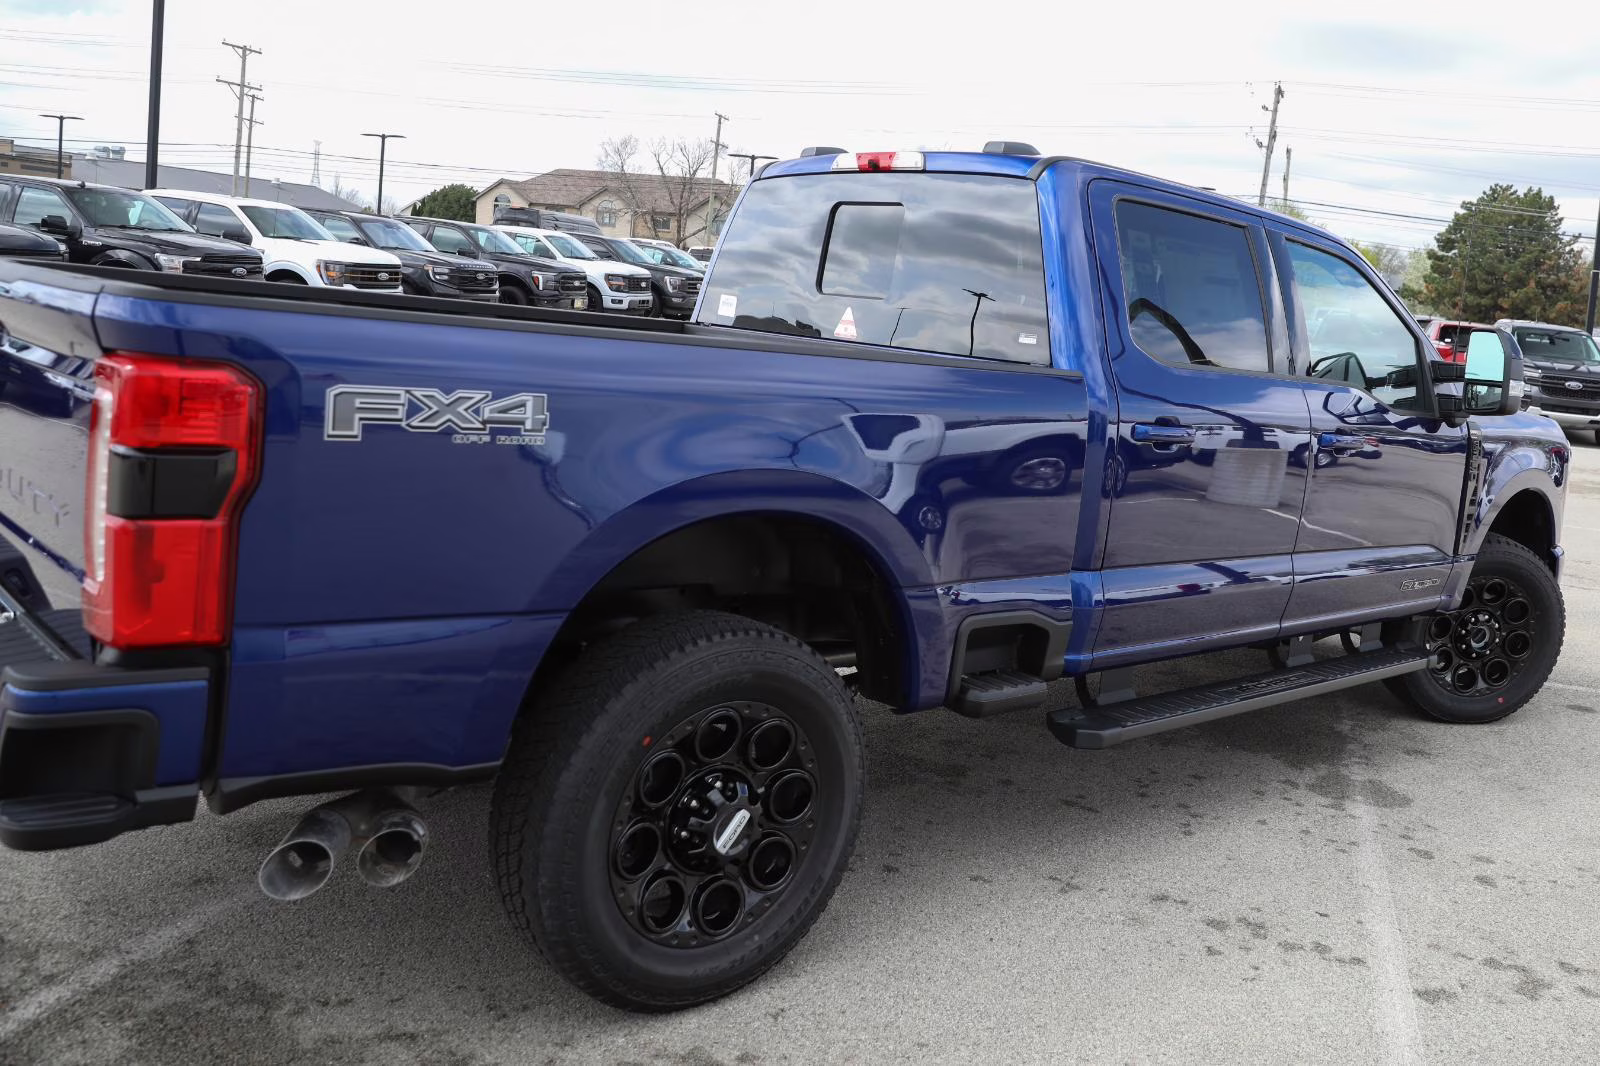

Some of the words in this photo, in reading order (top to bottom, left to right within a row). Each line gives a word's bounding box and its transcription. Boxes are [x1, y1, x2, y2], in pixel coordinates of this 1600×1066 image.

[324, 384, 549, 441] FX4
[0, 467, 70, 529] UTY
[723, 815, 747, 849] FORD
